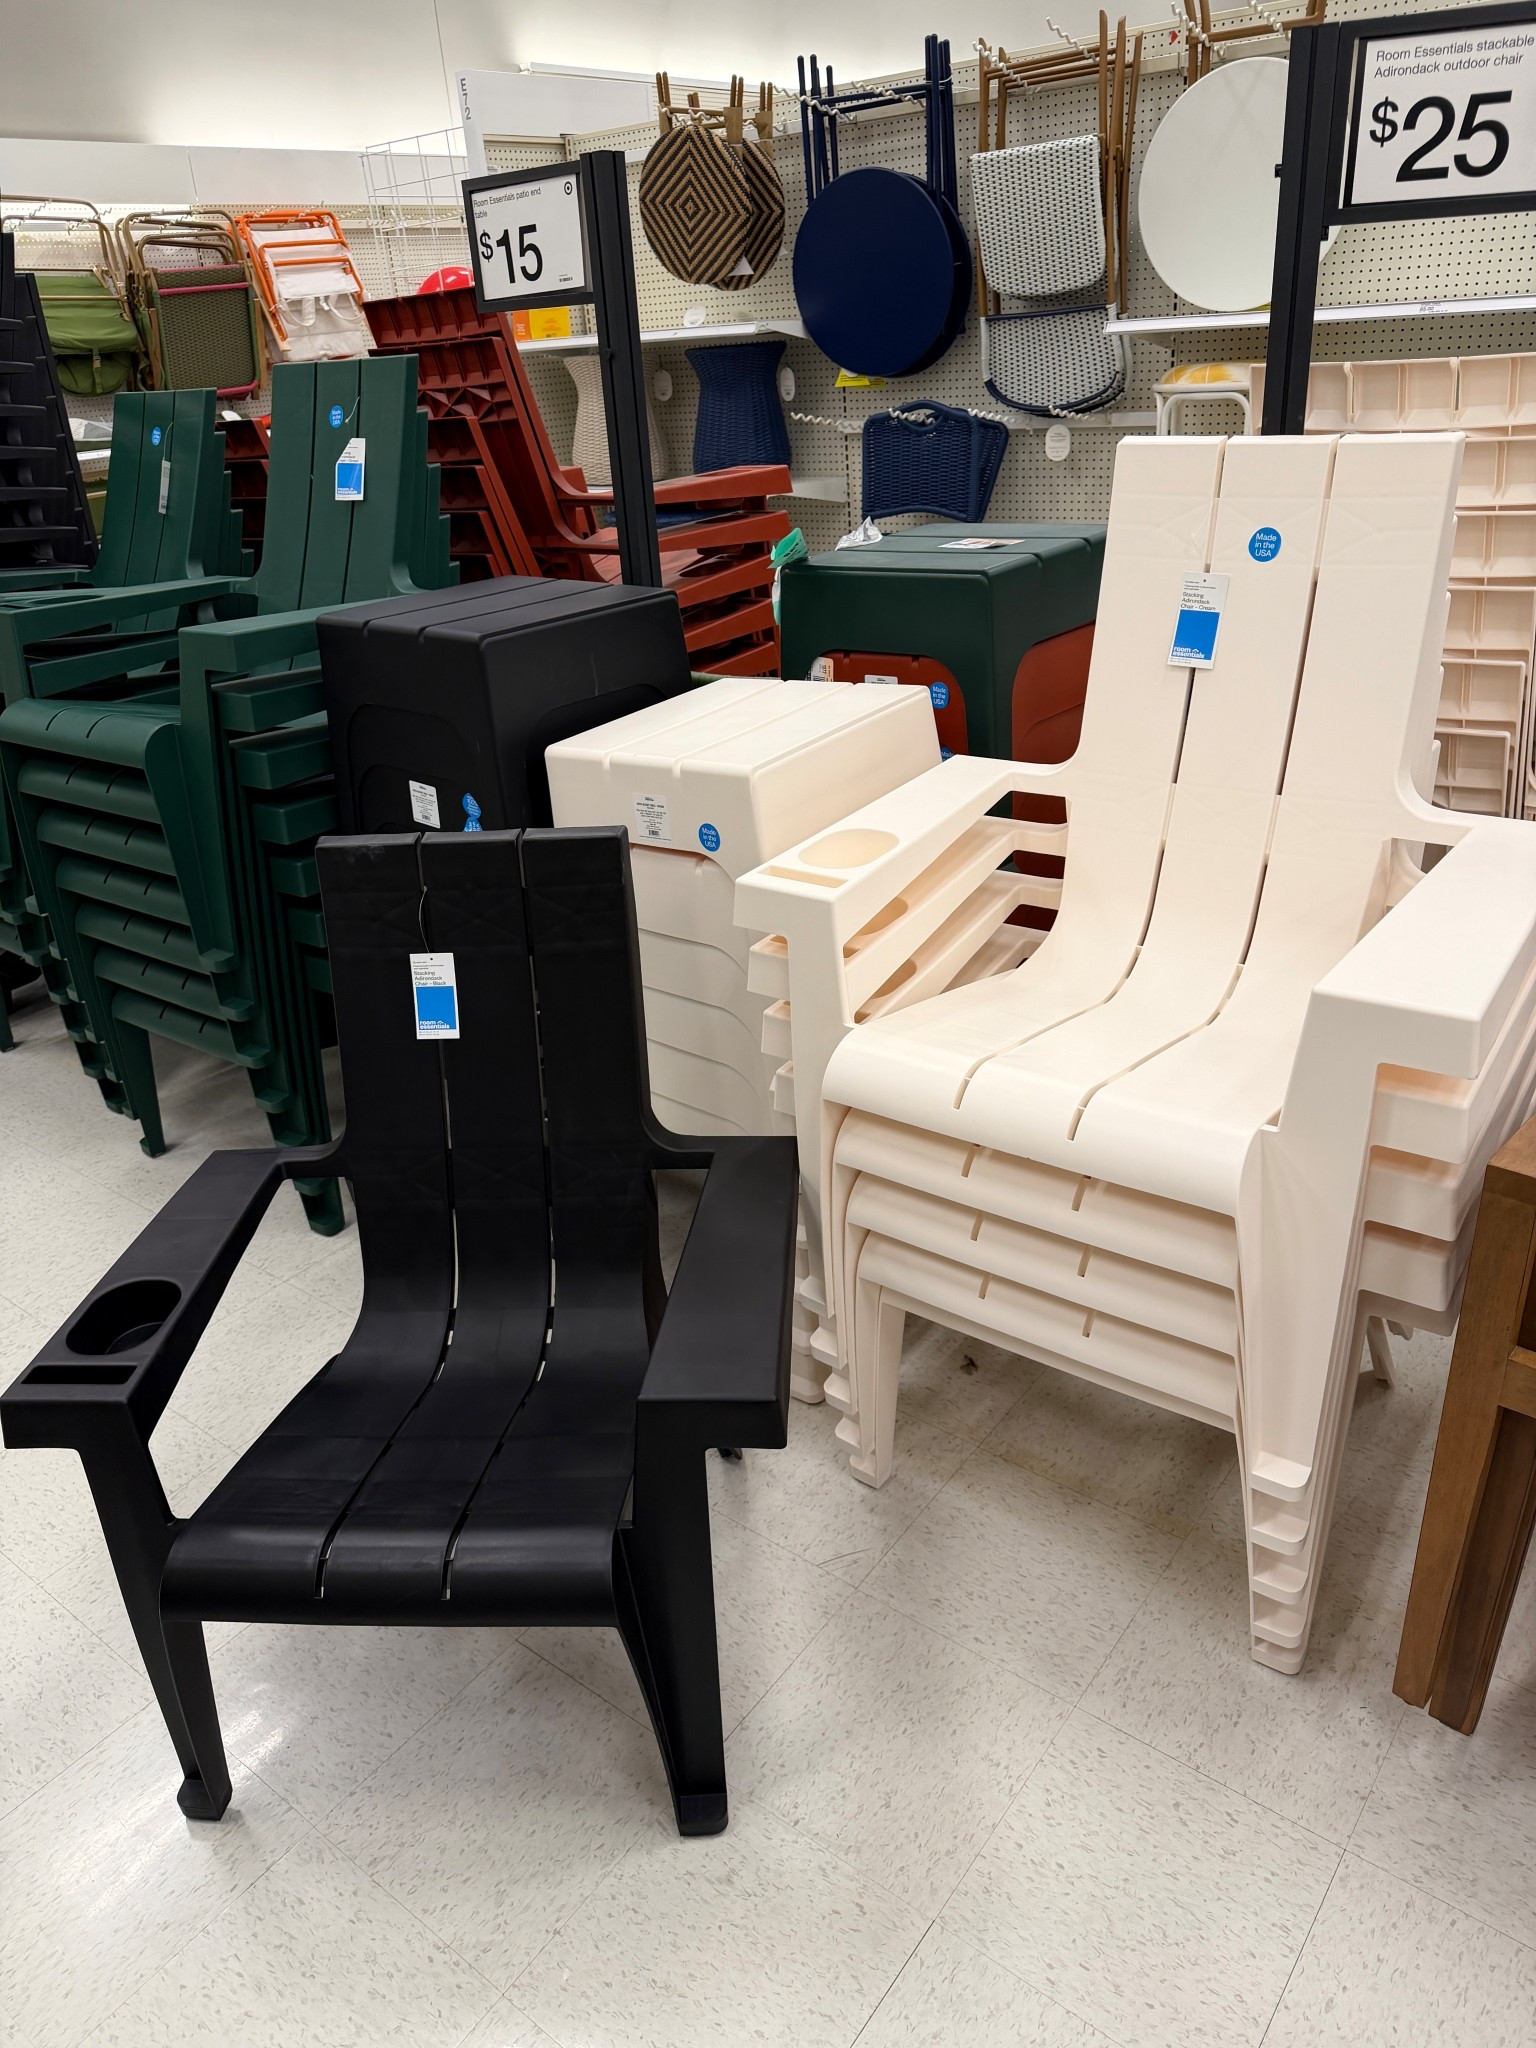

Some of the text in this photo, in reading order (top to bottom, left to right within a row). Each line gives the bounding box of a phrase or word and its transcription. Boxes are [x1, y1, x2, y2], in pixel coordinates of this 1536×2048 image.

[1376, 34, 1535, 62] Room Essentials stackable
[1374, 53, 1524, 78] Adirondack outdoor chair
[1369, 90, 1513, 182] $25
[473, 186, 542, 208] Room Essentials patio end
[474, 210, 488, 219] table
[480, 223, 543, 284] $15
[1256, 533, 1277, 541] Made
[1255, 540, 1275, 549] in the
[1255, 549, 1272, 557] USA
[933, 698, 944, 706] USA
[702, 828, 716, 836] Made
[704, 840, 716, 848] USA
